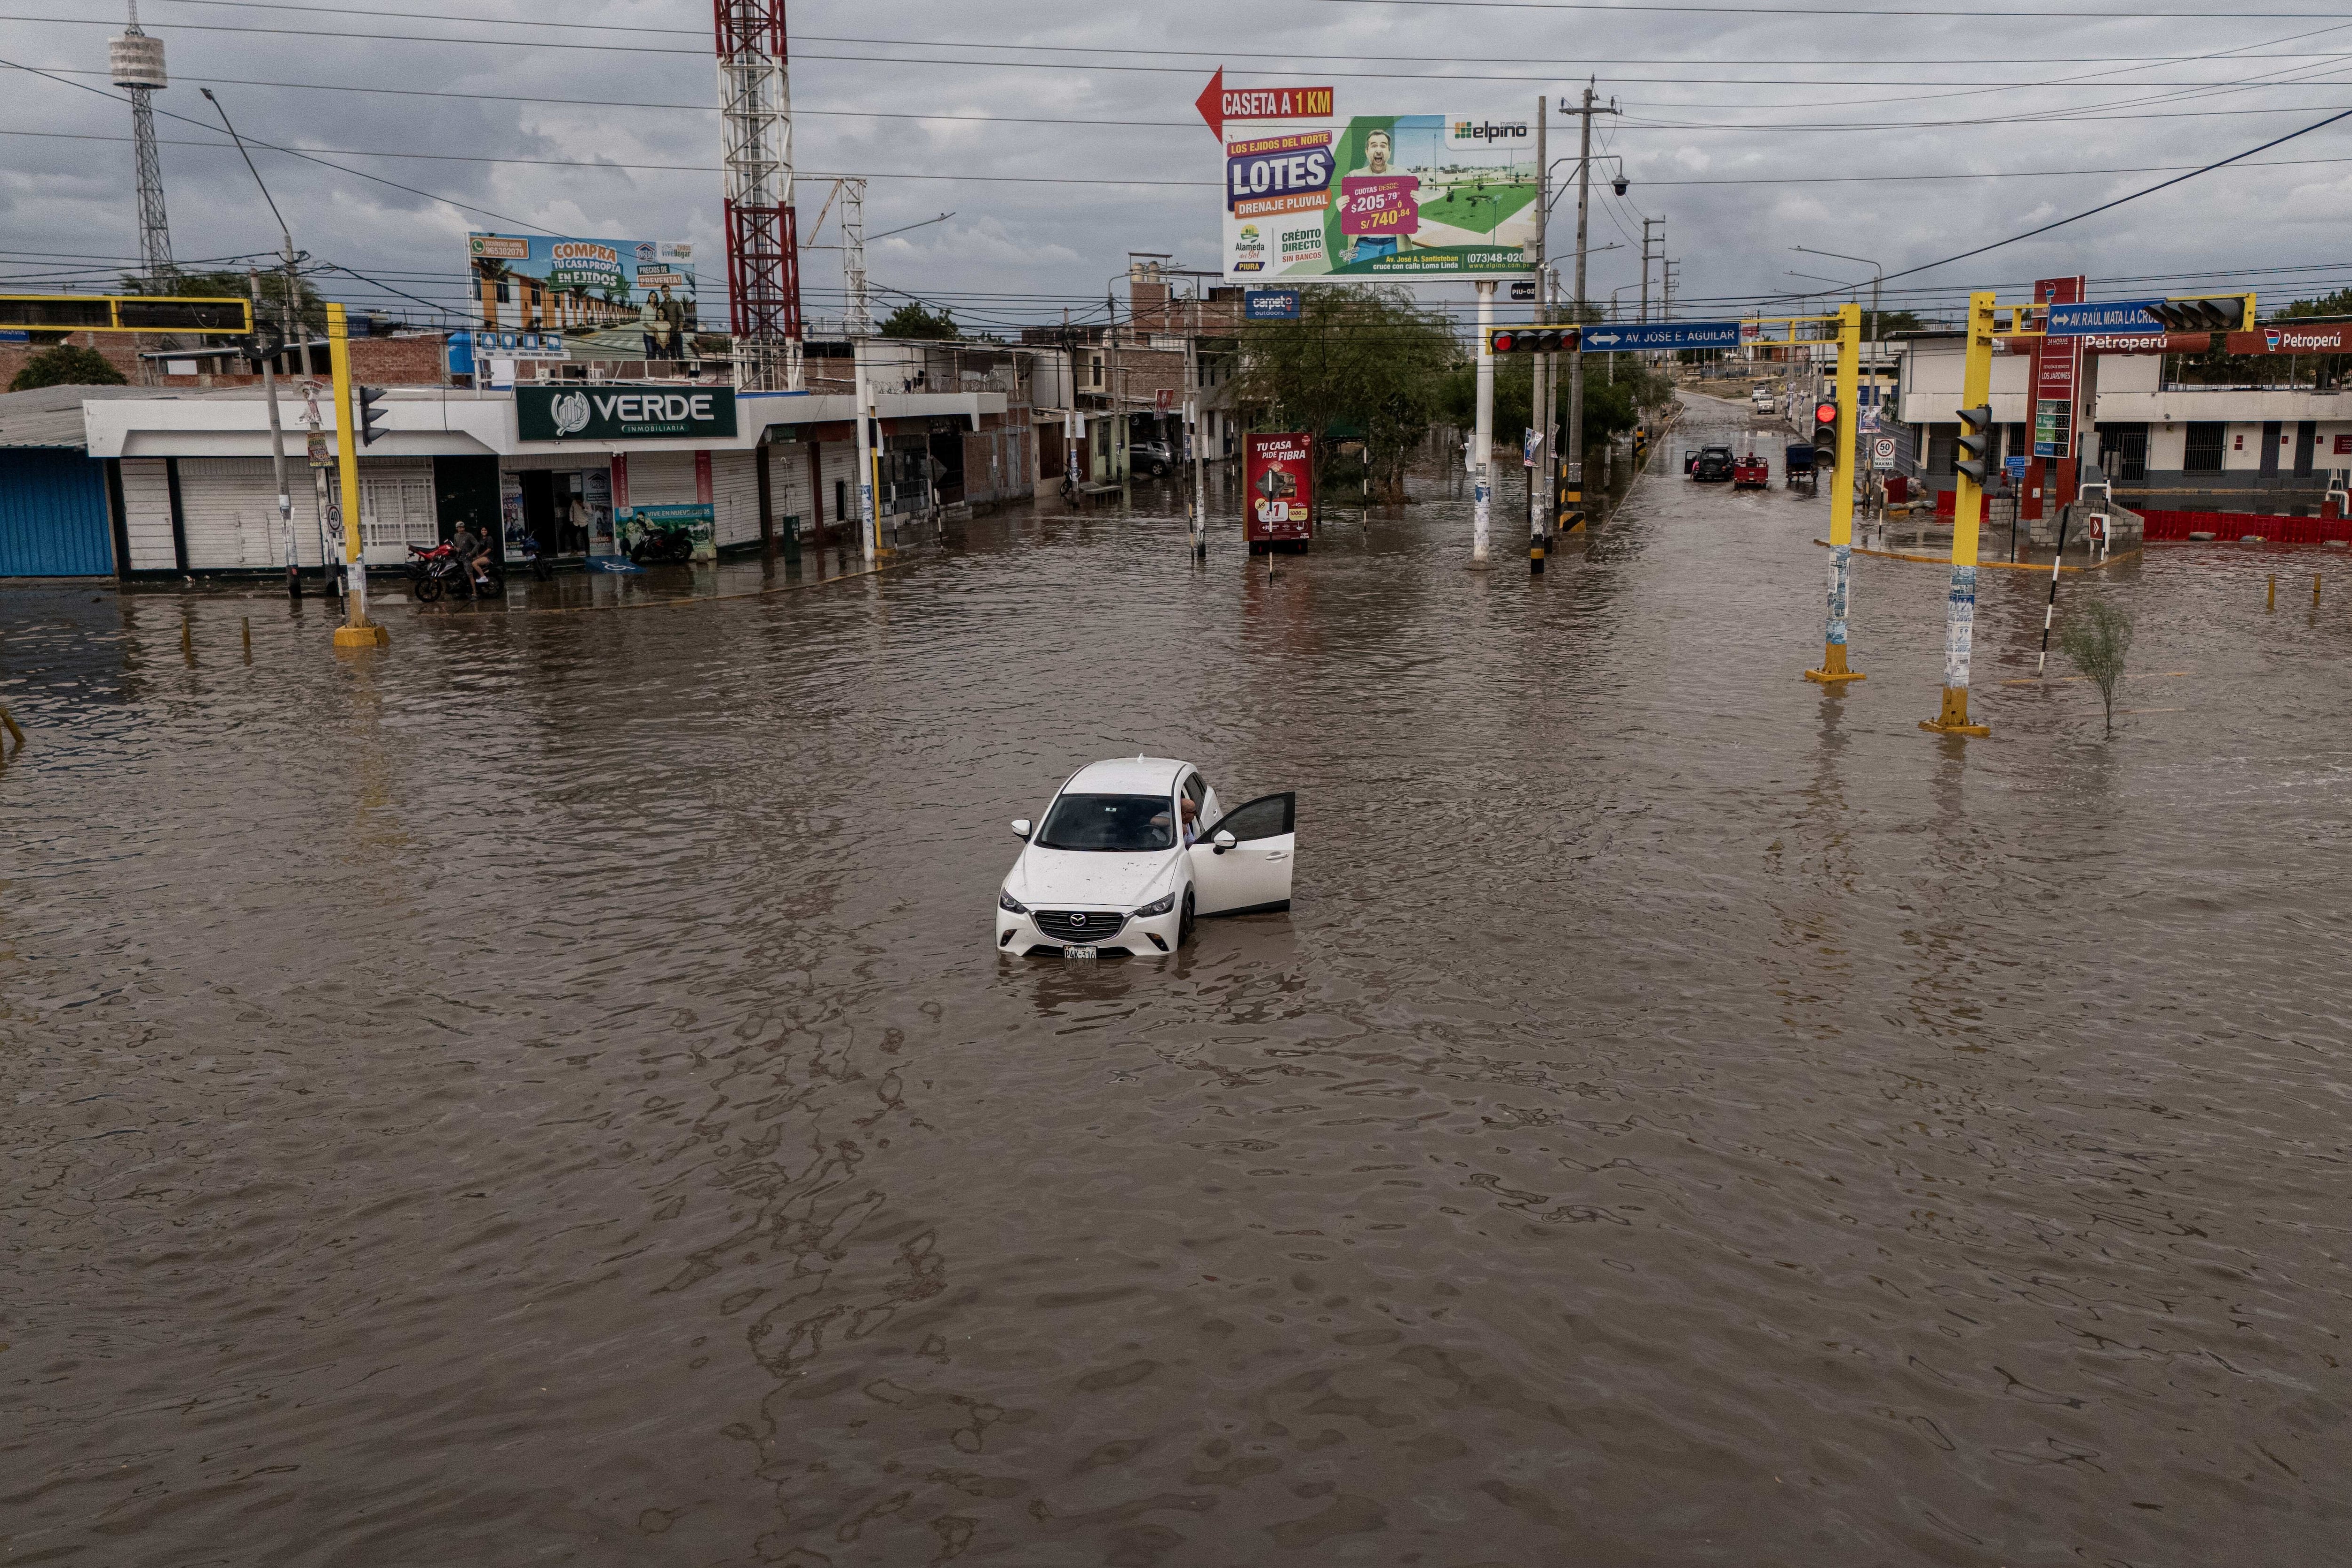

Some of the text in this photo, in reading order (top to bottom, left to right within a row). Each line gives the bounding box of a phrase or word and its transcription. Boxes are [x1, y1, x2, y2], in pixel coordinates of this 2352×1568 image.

[1223, 91, 1330, 116] CASETA A 1 KM
[1473, 121, 1527, 143] elpino
[1231, 133, 1328, 154] LOS EJIDOS DEL NORTE
[1233, 153, 1327, 195] LOTES
[1354, 186, 1377, 196] CUOTAS
[1239, 194, 1328, 214] DRENAJE PLUVIAL
[1360, 208, 1410, 230] S/ 740.84
[1281, 228, 1321, 242] CRÉDITO
[485, 247, 524, 256] 965302079
[553, 243, 618, 263] COMPRA
[1235, 242, 1265, 252] Alameda
[1282, 239, 1321, 253] DIRECTO
[1248, 250, 1260, 259] Sol
[1295, 252, 1322, 261] BANCOS
[553, 260, 621, 274] TU CASA PROPIA
[1239, 262, 1260, 270] PIURA
[558, 271, 617, 287] EN EJIDOS
[640, 276, 681, 285] PREVENTA!
[2069, 308, 2160, 326] AV. RAÚL MATA LA CRU
[1625, 332, 1641, 343] AV.
[1675, 330, 1685, 341] E.
[1687, 329, 1735, 341] AGUILAR
[2085, 335, 2167, 351] Petroperú
[2283, 332, 2341, 350] Petroperú
[593, 394, 715, 421] VERDE
[1256, 440, 1292, 451] TU CASA
[1278, 450, 1306, 461] FIBRA
[331, 511, 338, 522] 40
[1274, 504, 1280, 516] 1
[1065, 950, 1096, 959] P4K-316
